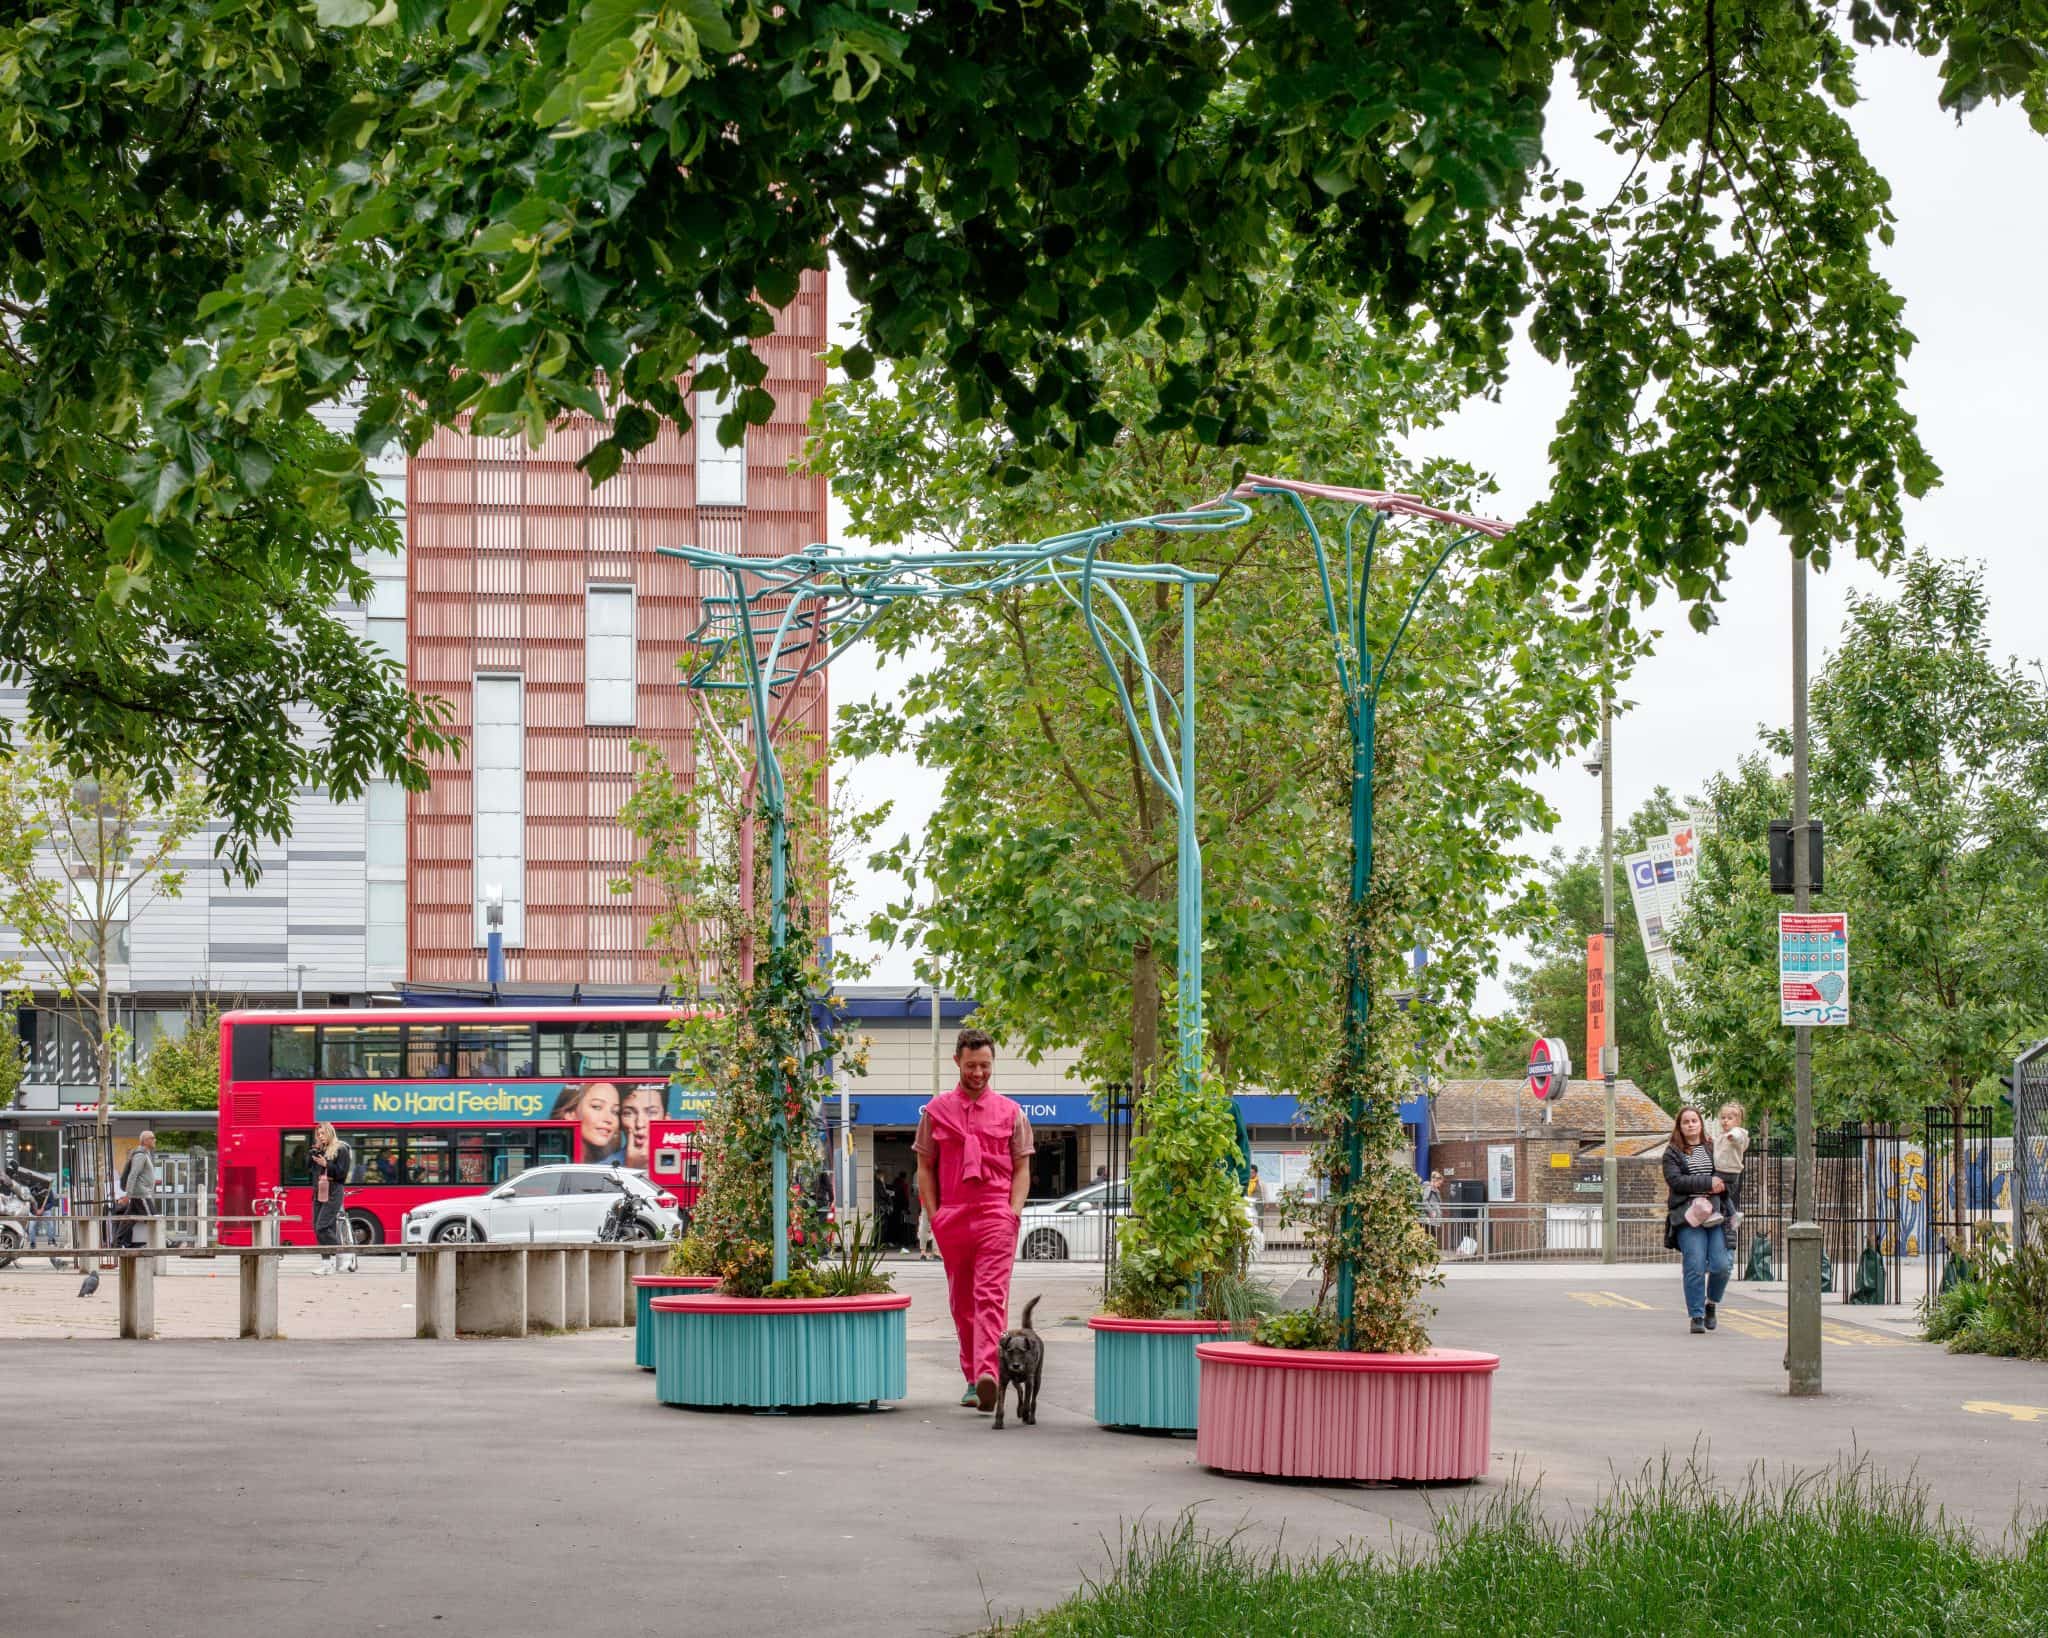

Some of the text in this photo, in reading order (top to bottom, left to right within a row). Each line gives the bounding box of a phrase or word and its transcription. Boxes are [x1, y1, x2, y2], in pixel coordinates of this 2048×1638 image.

[373, 1087, 543, 1116] No Hard Feelings
